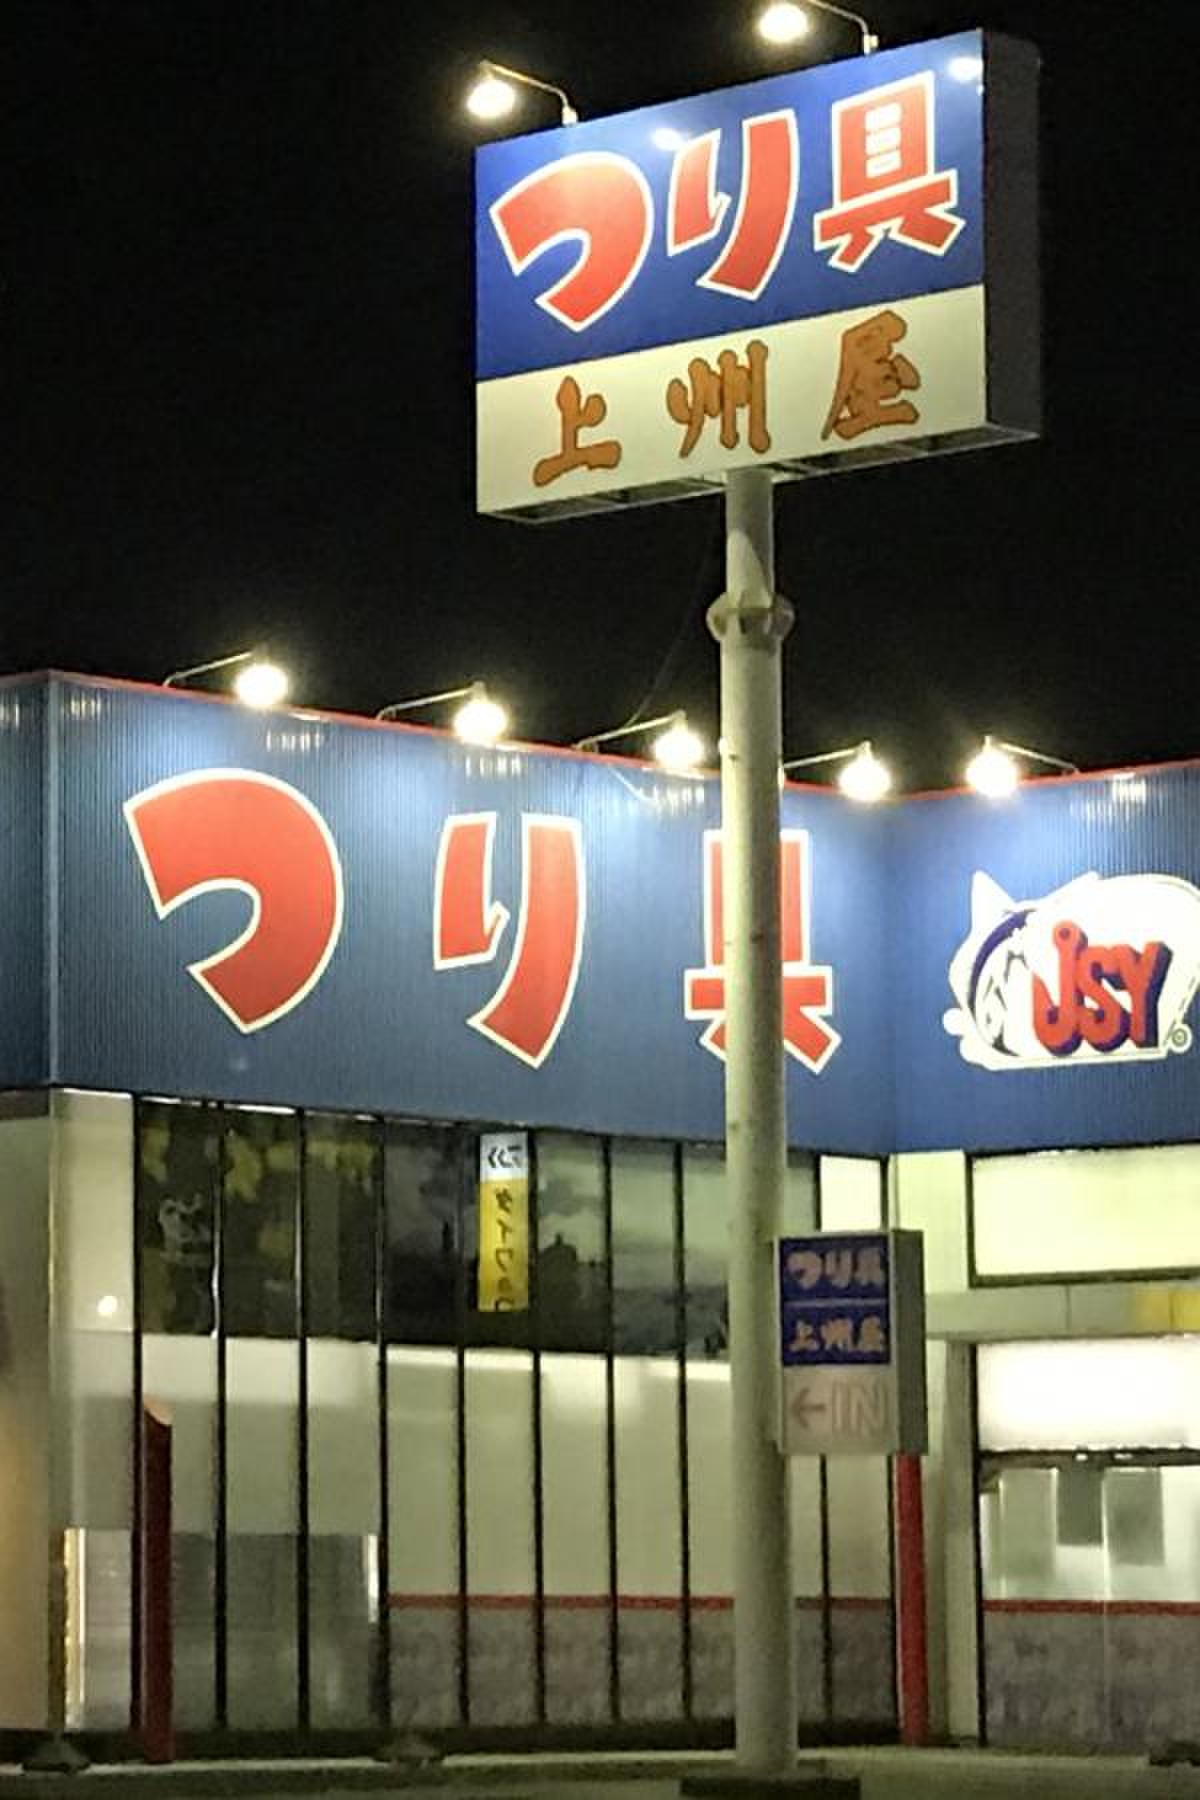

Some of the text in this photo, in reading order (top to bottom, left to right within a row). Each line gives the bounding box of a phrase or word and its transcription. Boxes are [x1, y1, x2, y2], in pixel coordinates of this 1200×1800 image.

[490, 71, 966, 332] つり具
[533, 310, 921, 487] 上州屋
[831, 1375, 891, 1436] IN
